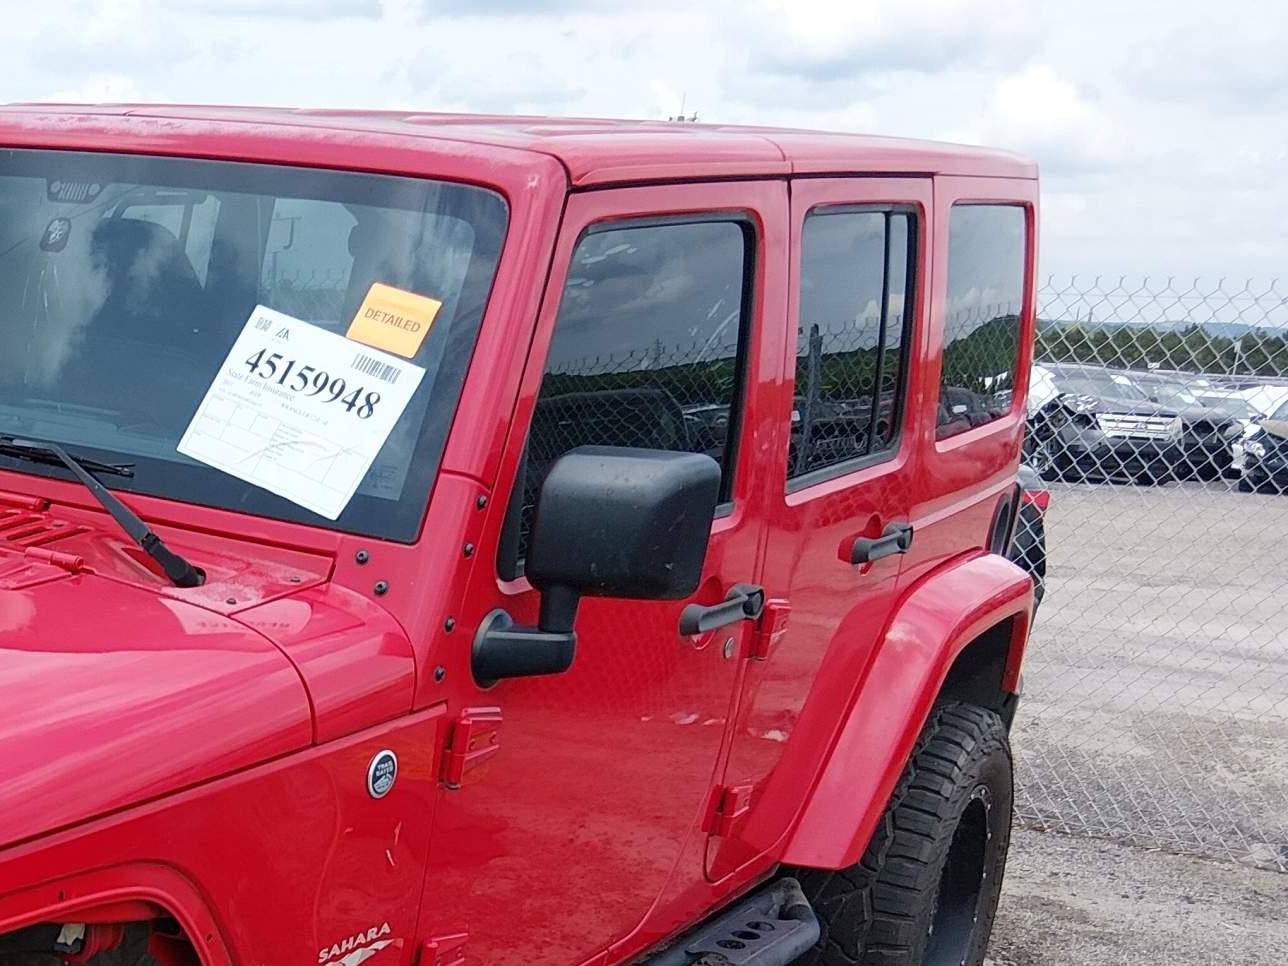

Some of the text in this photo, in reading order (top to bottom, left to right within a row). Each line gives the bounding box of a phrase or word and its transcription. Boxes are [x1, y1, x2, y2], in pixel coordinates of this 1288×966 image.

[364, 307, 421, 333] DETAILED
[245, 348, 381, 420] 45159948
[318, 922, 391, 963] SAHARA
